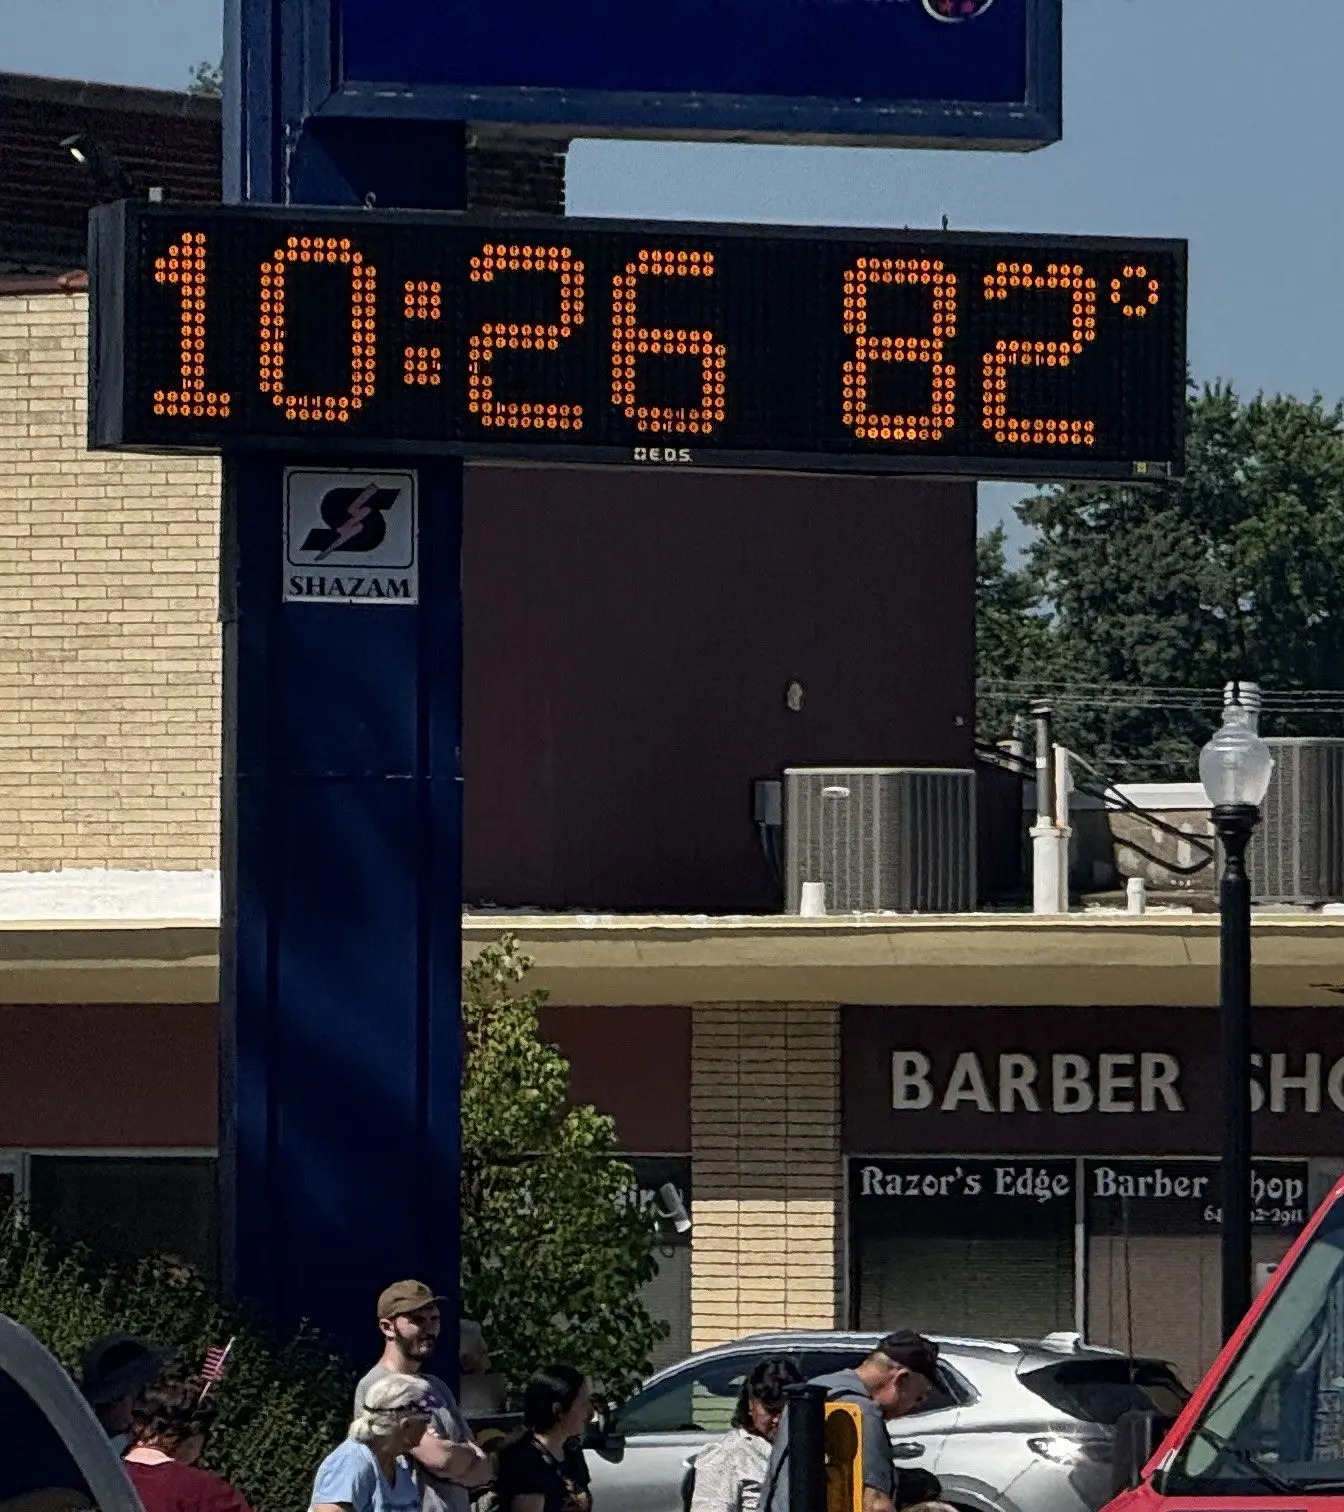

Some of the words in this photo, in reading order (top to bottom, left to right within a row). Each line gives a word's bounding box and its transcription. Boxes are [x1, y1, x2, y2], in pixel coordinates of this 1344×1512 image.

[152, 231, 729, 436] 10:26
[841, 256, 1160, 446] 82°
[288, 575, 412, 600] SHAZAM
[891, 1051, 1184, 1114] BARBER
[860, 1165, 981, 1199] Razor's
[995, 1168, 1071, 1204] Edge
[1093, 1167, 1209, 1200] Barber
[1250, 1169, 1303, 1206] hop
